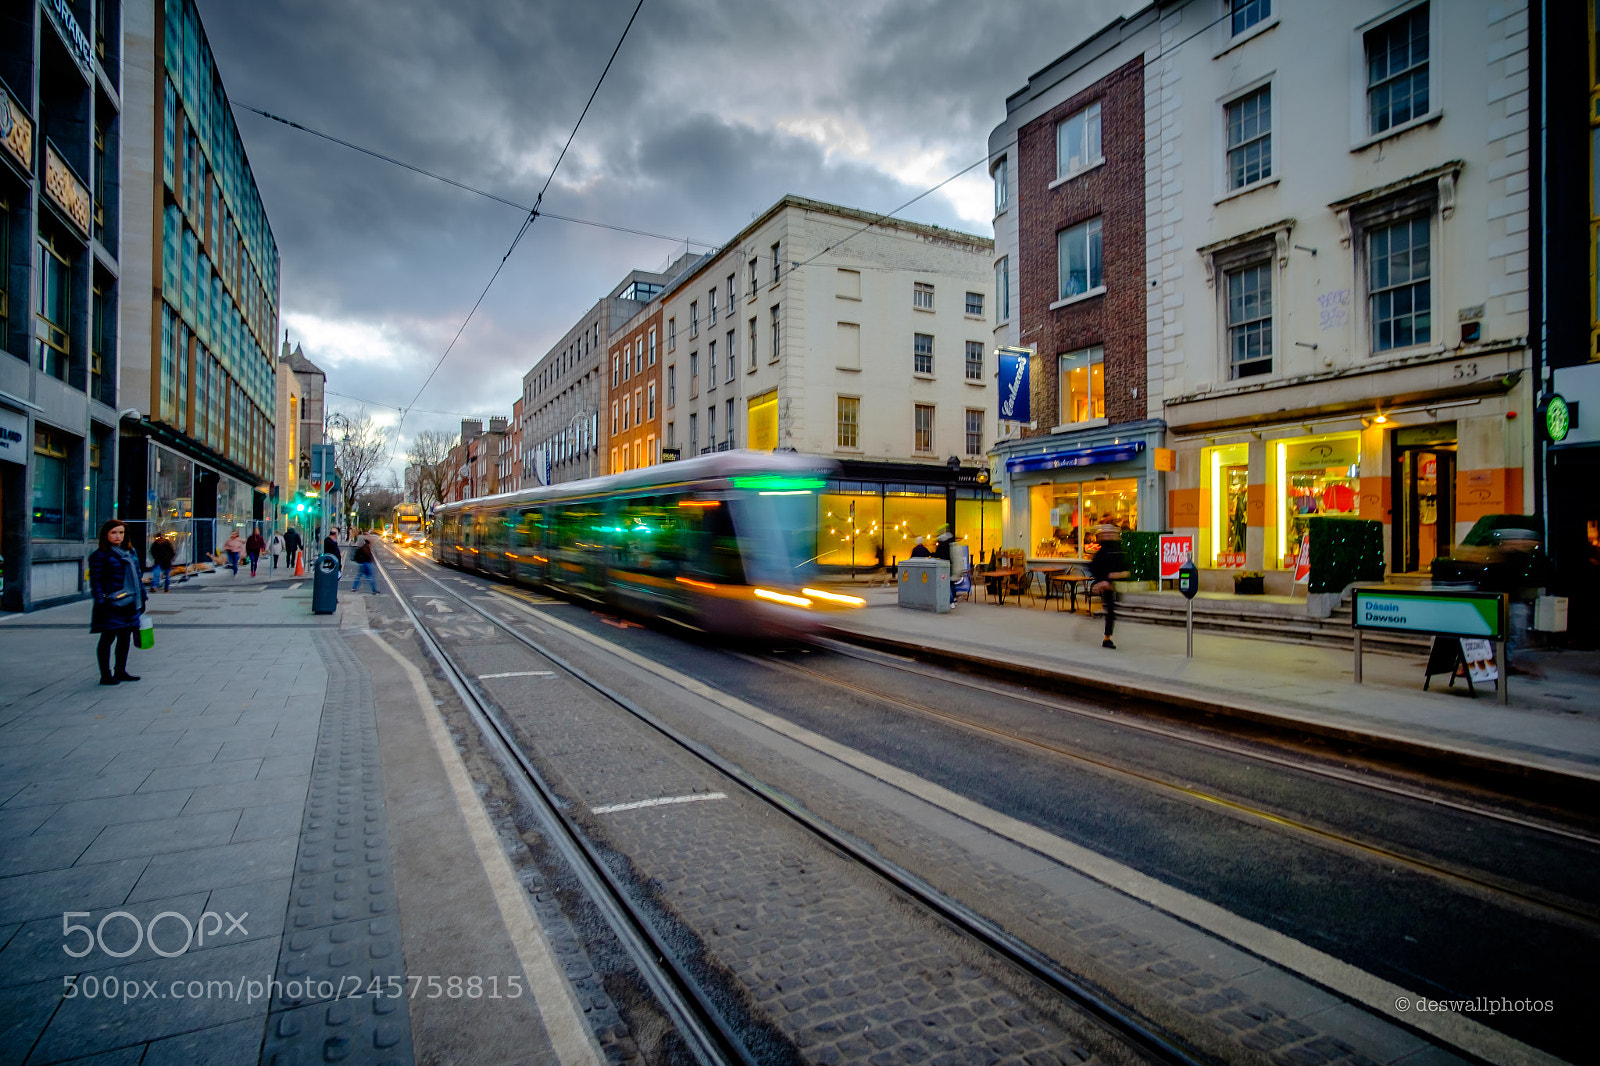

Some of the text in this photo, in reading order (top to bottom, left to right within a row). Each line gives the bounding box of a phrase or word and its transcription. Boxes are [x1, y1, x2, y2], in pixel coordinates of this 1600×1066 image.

[1453, 363, 1478, 379] 53
[1163, 542, 1190, 555] SALE
[1365, 612, 1407, 624] Dawson
